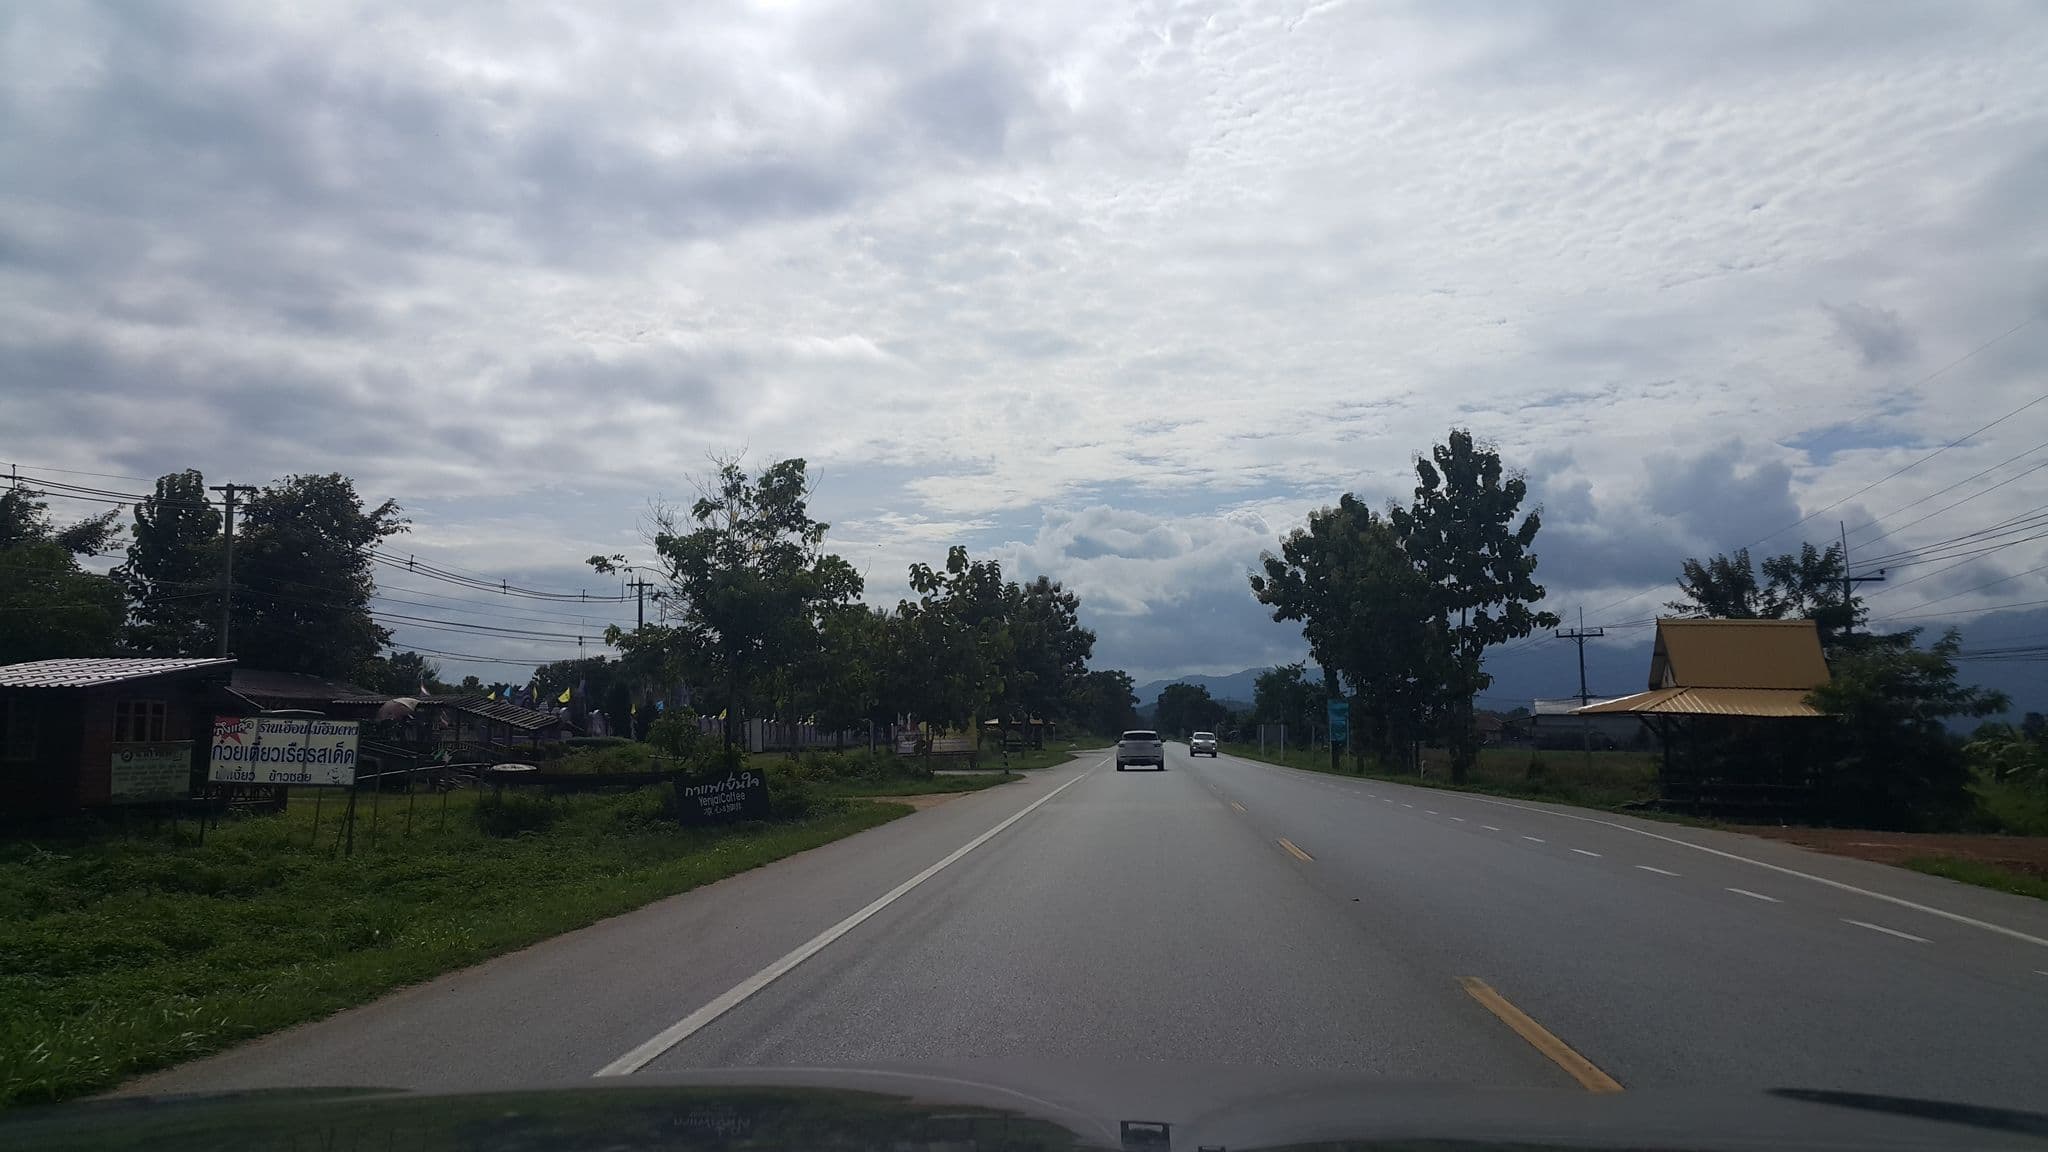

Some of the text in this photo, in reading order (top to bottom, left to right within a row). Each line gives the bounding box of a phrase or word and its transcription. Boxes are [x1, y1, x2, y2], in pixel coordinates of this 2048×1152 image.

[212, 735, 355, 765] ก๋วยเตี๋ยวเรือรสเด็ด
[269, 769, 312, 783] ข้าวซอย
[685, 771, 760, 797] กาแฟเย็นใจ
